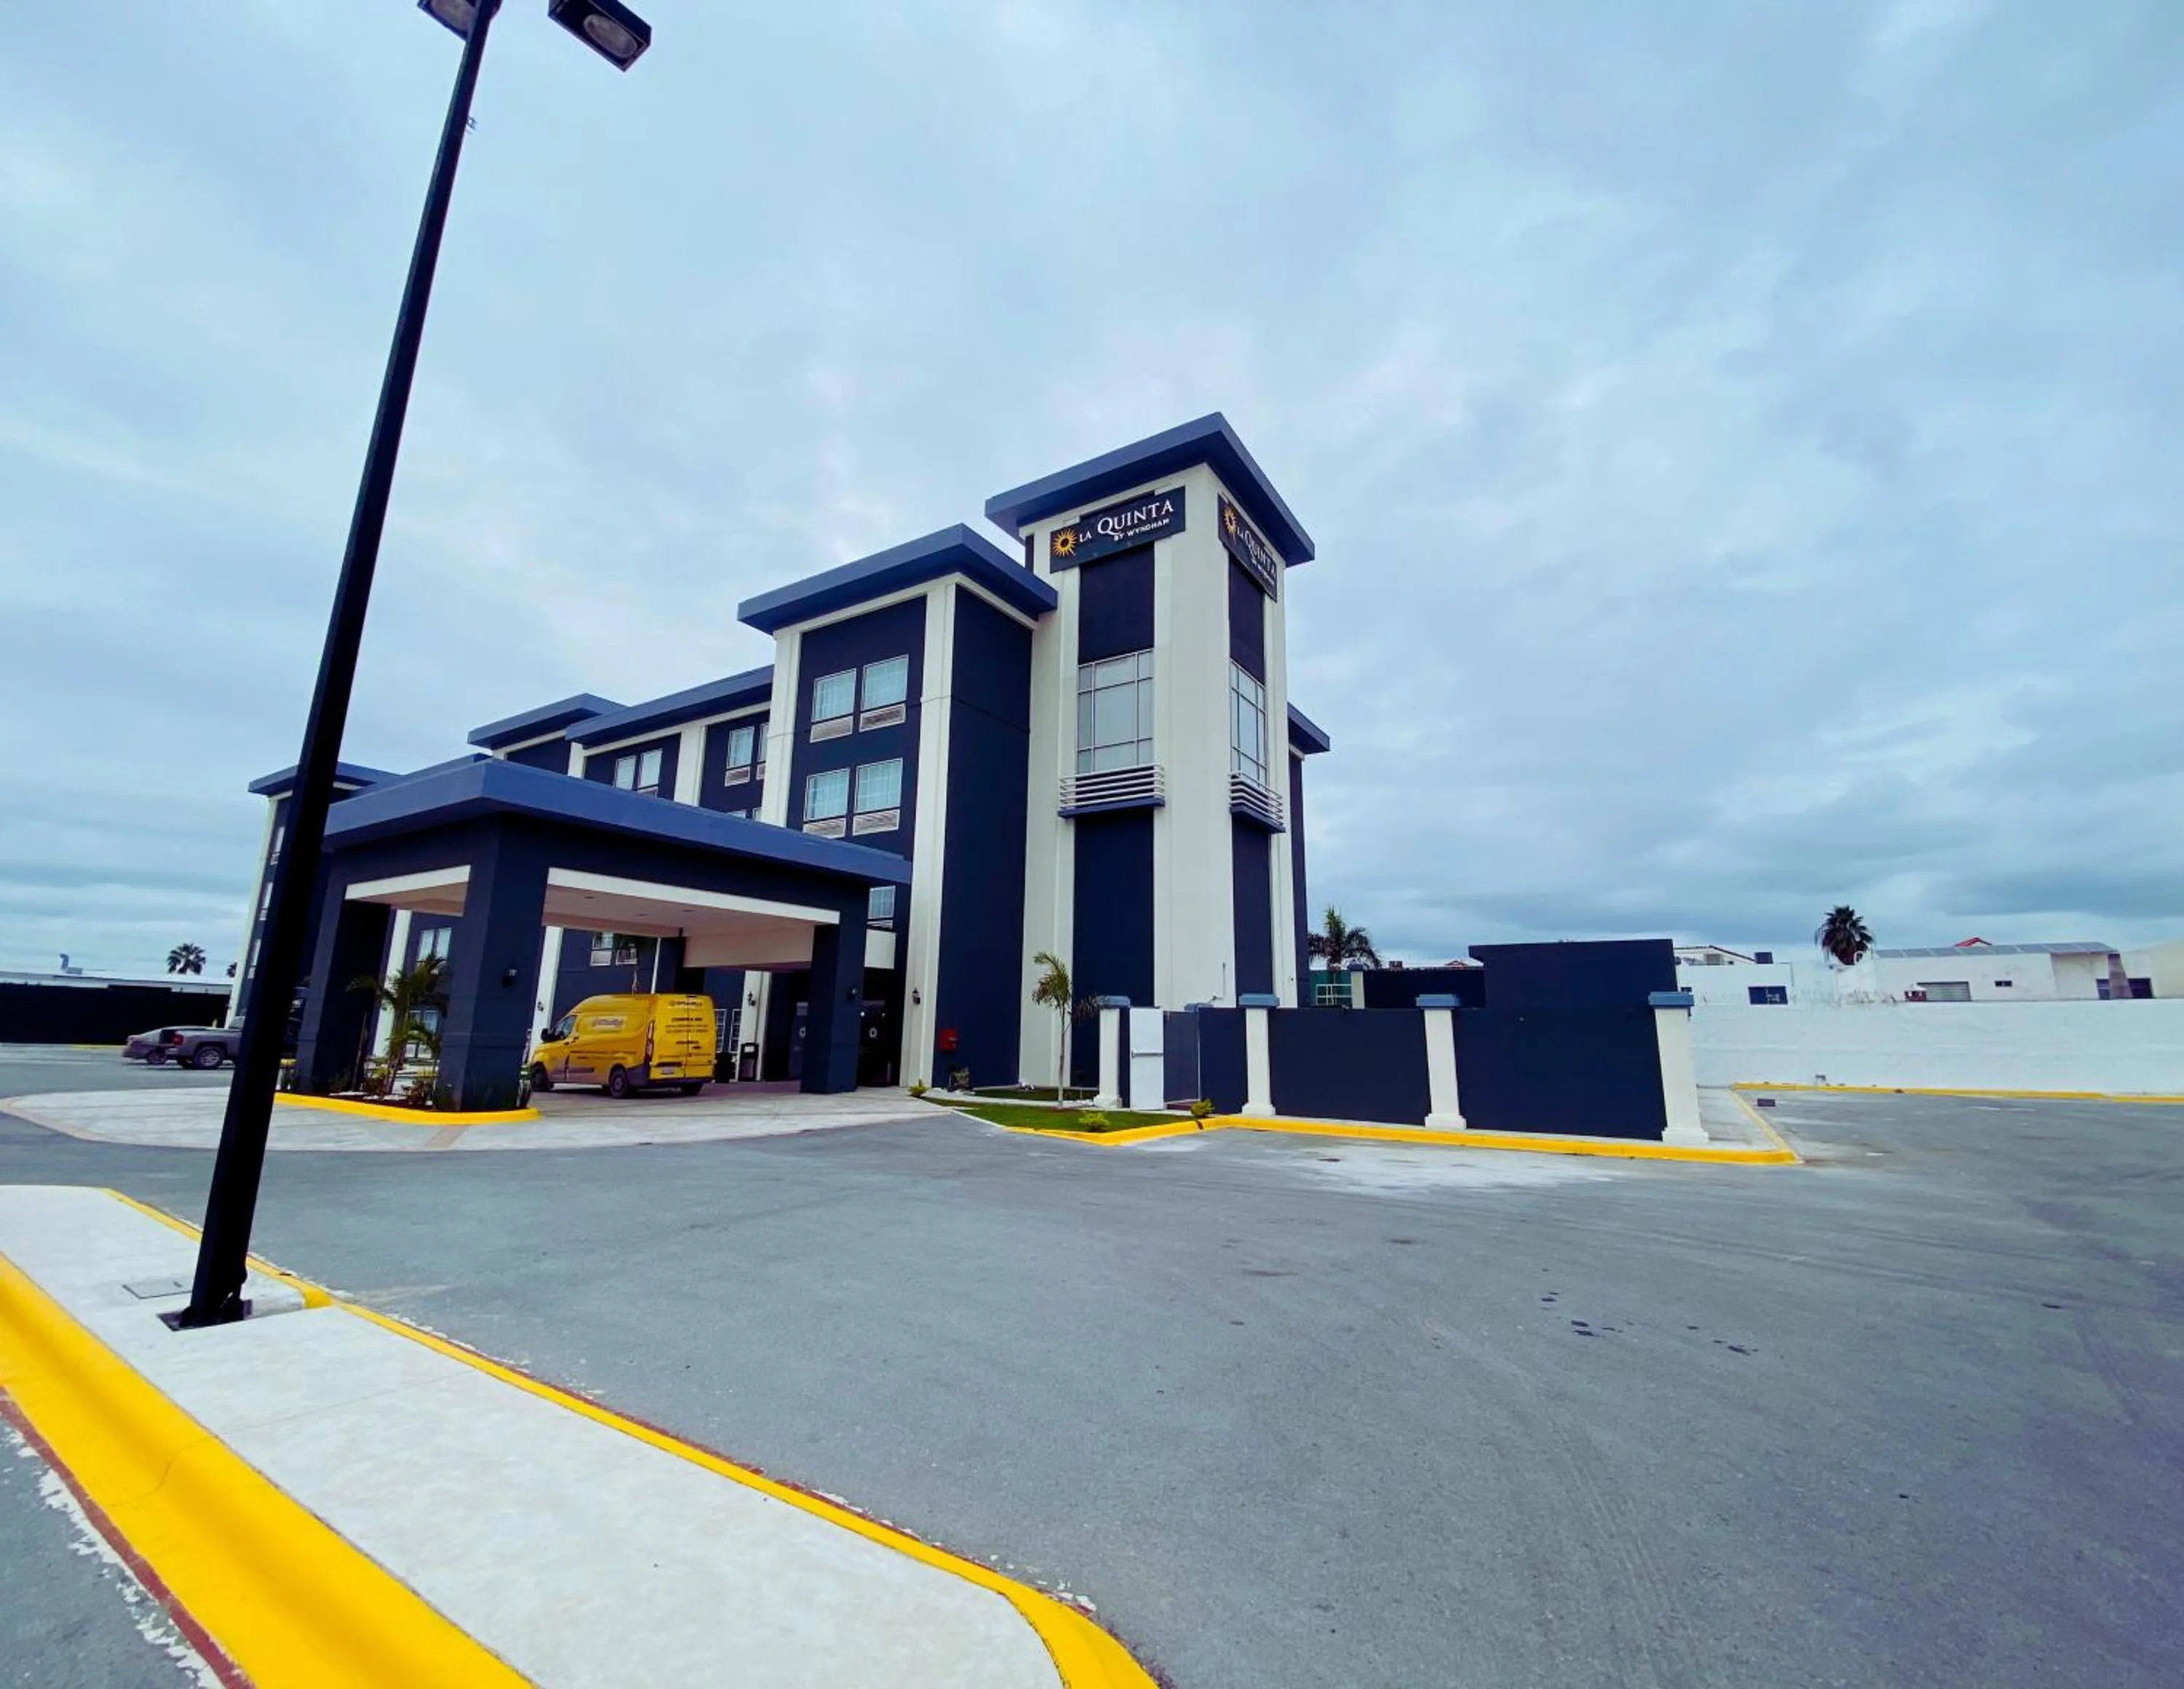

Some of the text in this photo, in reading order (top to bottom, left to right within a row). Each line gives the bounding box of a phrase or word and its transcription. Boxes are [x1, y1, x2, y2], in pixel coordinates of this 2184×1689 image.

[1080, 499, 1174, 542] LA QUINTA
[1114, 518, 1170, 541] BY WYNDHAM
